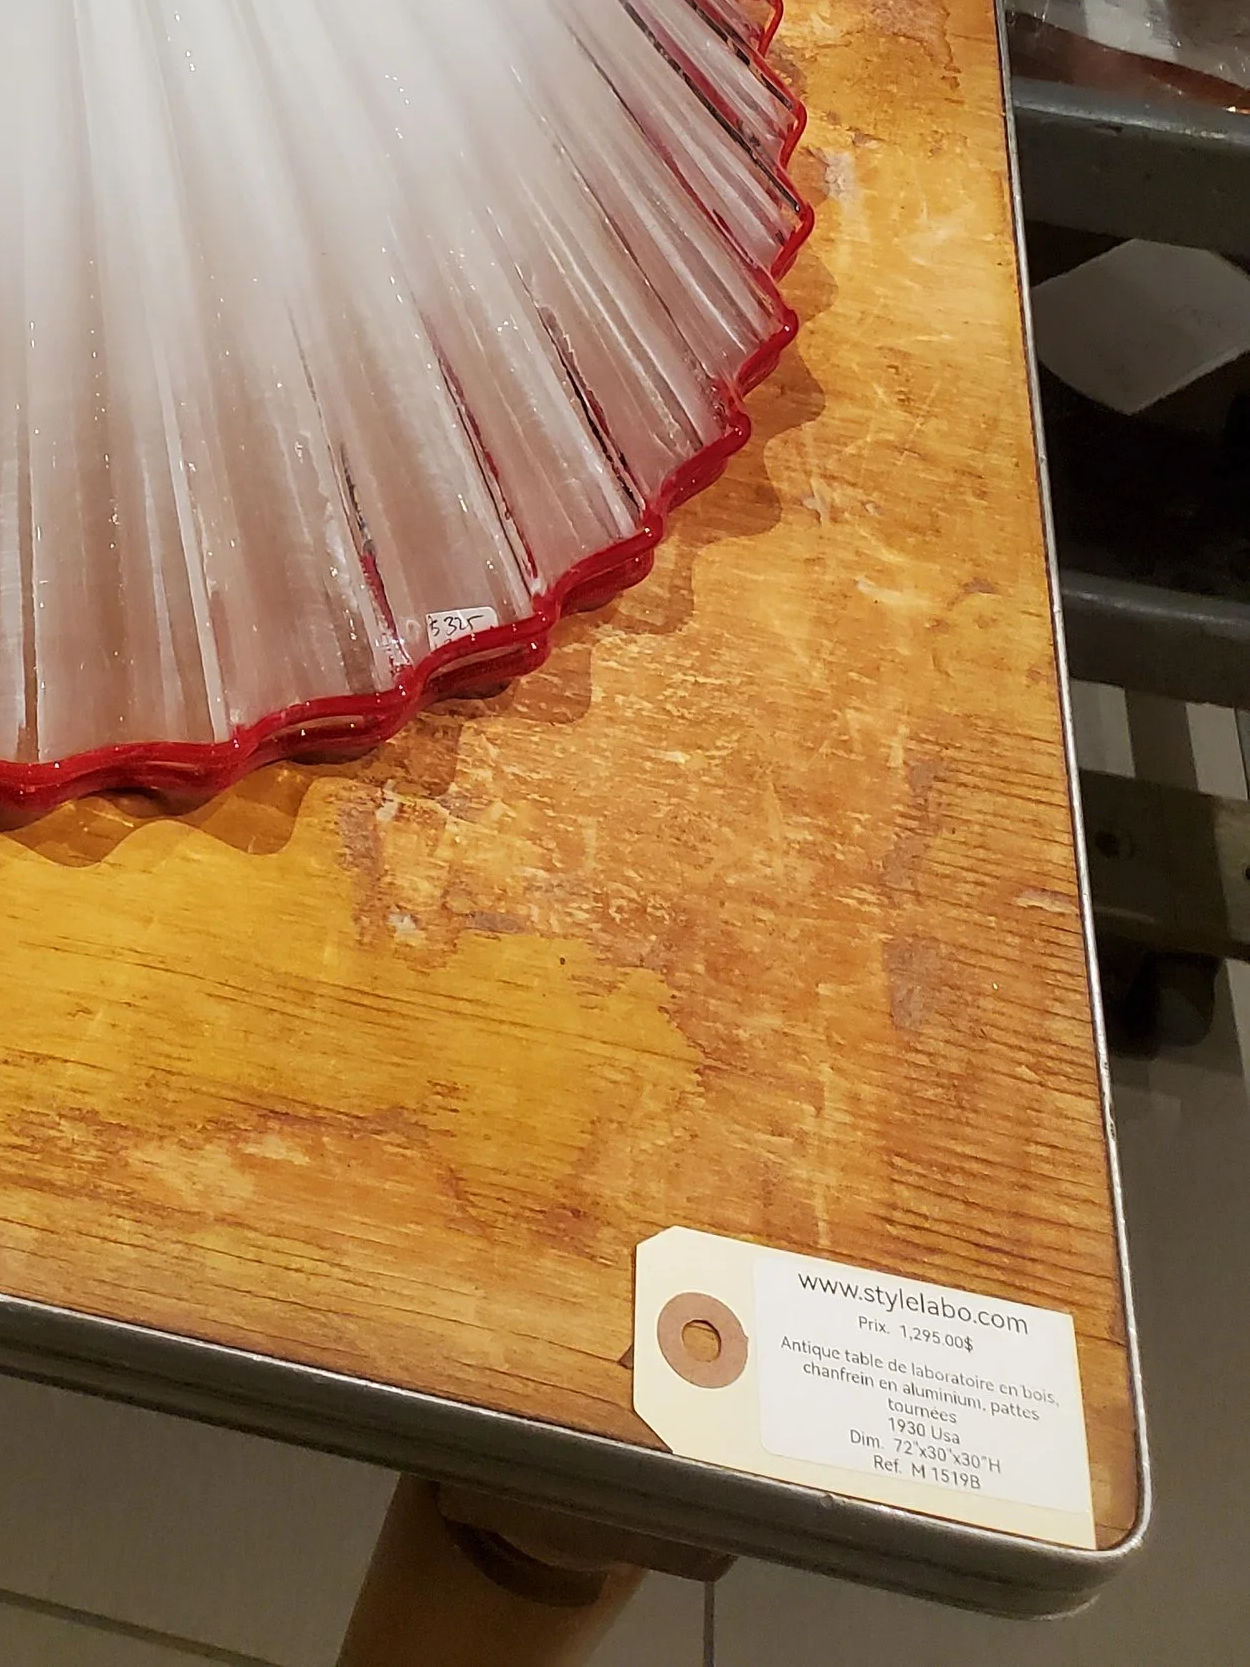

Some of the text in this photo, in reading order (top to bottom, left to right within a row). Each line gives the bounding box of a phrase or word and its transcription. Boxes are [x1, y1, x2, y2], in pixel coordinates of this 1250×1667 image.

[797, 1272, 1029, 1335] www.stylelabo.com
[857, 1315, 975, 1354] Prix. 1,295.00$
[780, 1335, 1060, 1408] Antique table de laboratoire en bois,
[802, 1361, 875, 1388] chanfrein
[878, 1377, 899, 1392] en
[989, 1400, 1041, 1421] pattes
[849, 1428, 885, 1450] Dim.
[887, 1416, 961, 1445] 1930 Usa
[872, 1454, 982, 1490] Ref. M 1519B
